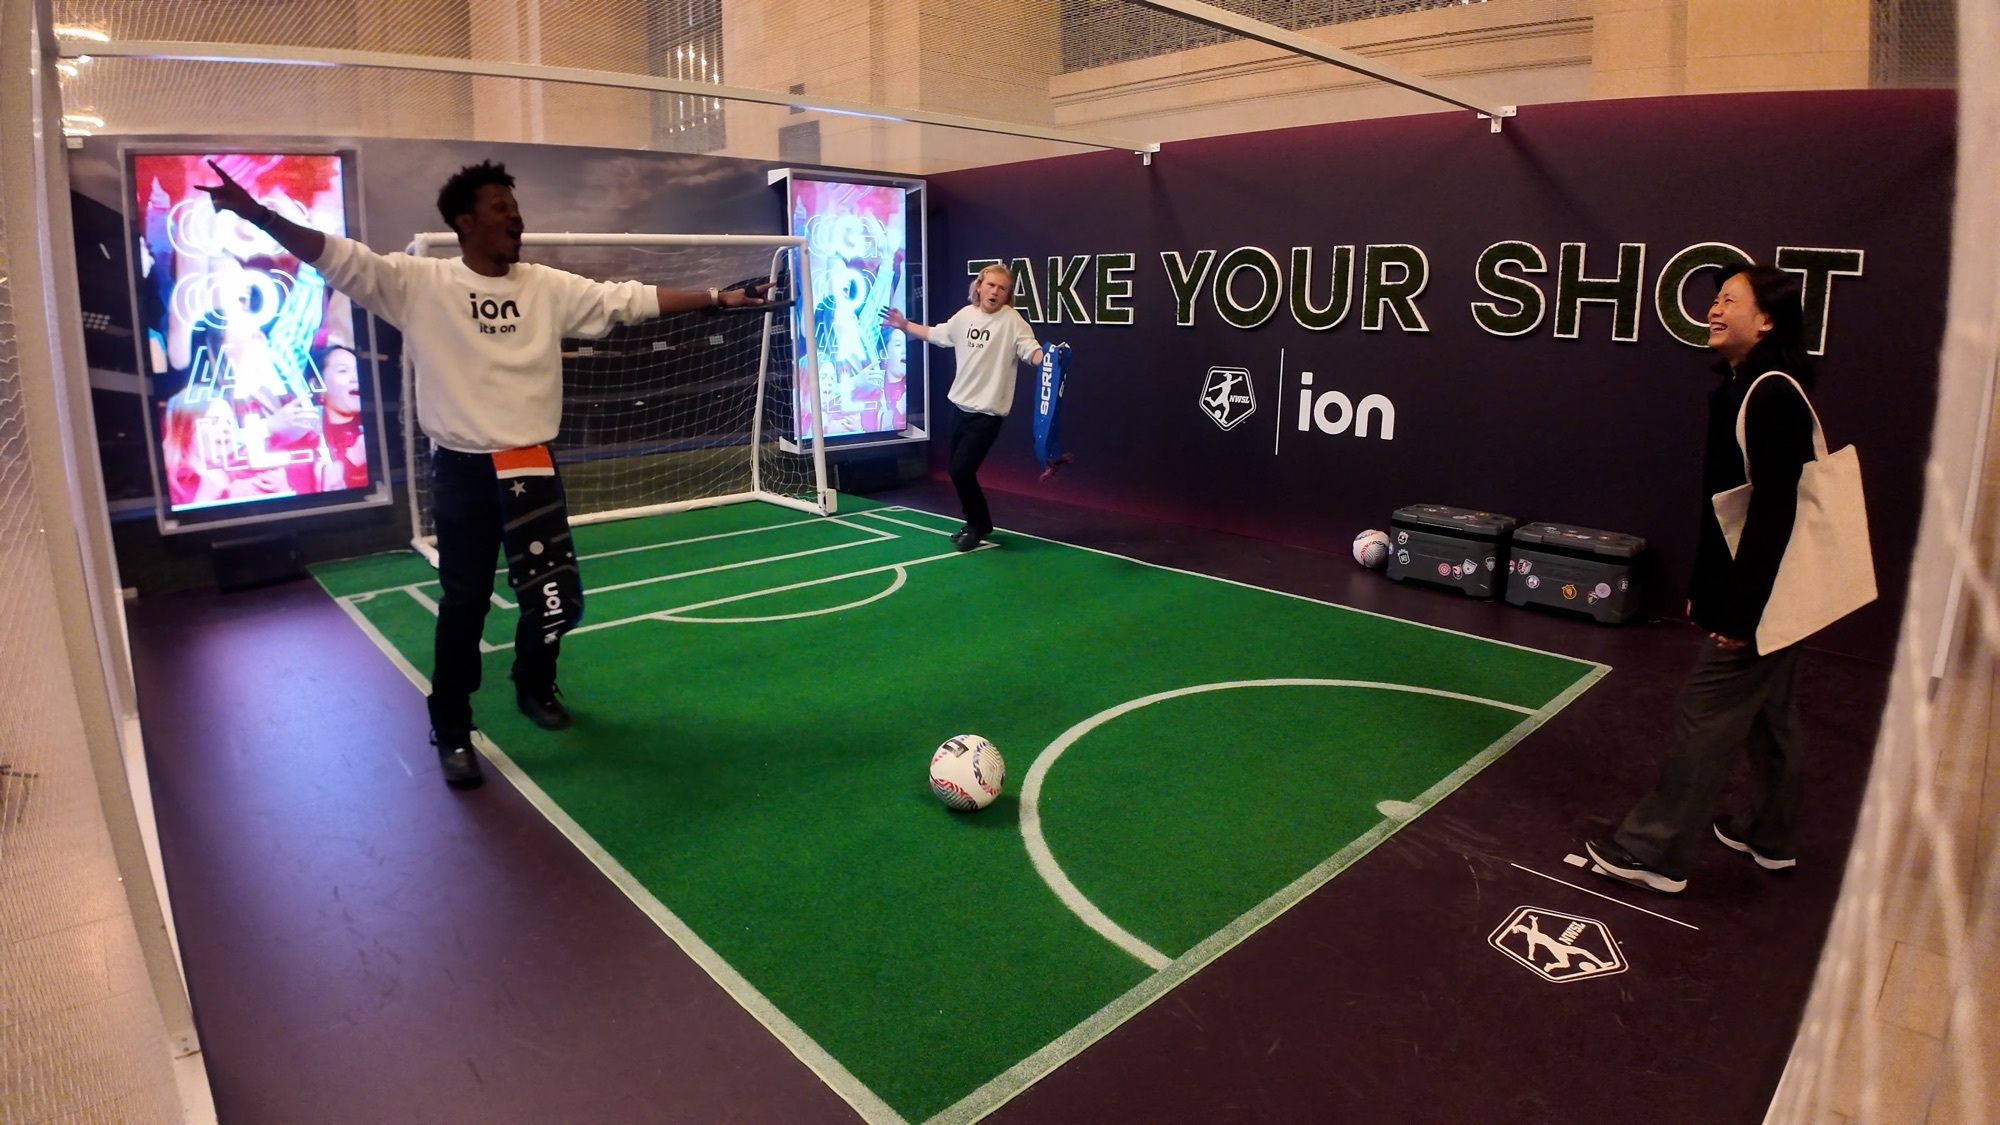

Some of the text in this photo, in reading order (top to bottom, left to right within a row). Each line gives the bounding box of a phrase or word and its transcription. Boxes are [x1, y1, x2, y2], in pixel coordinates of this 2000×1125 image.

[1160, 244, 1430, 332] YOUR
[469, 292, 521, 320] ion
[500, 324, 516, 334] on
[966, 323, 991, 341] ion
[1229, 394, 1251, 404] NWSL
[1298, 371, 1395, 440] ion
[542, 581, 563, 617] ion
[1558, 920, 1587, 946] NWSL
